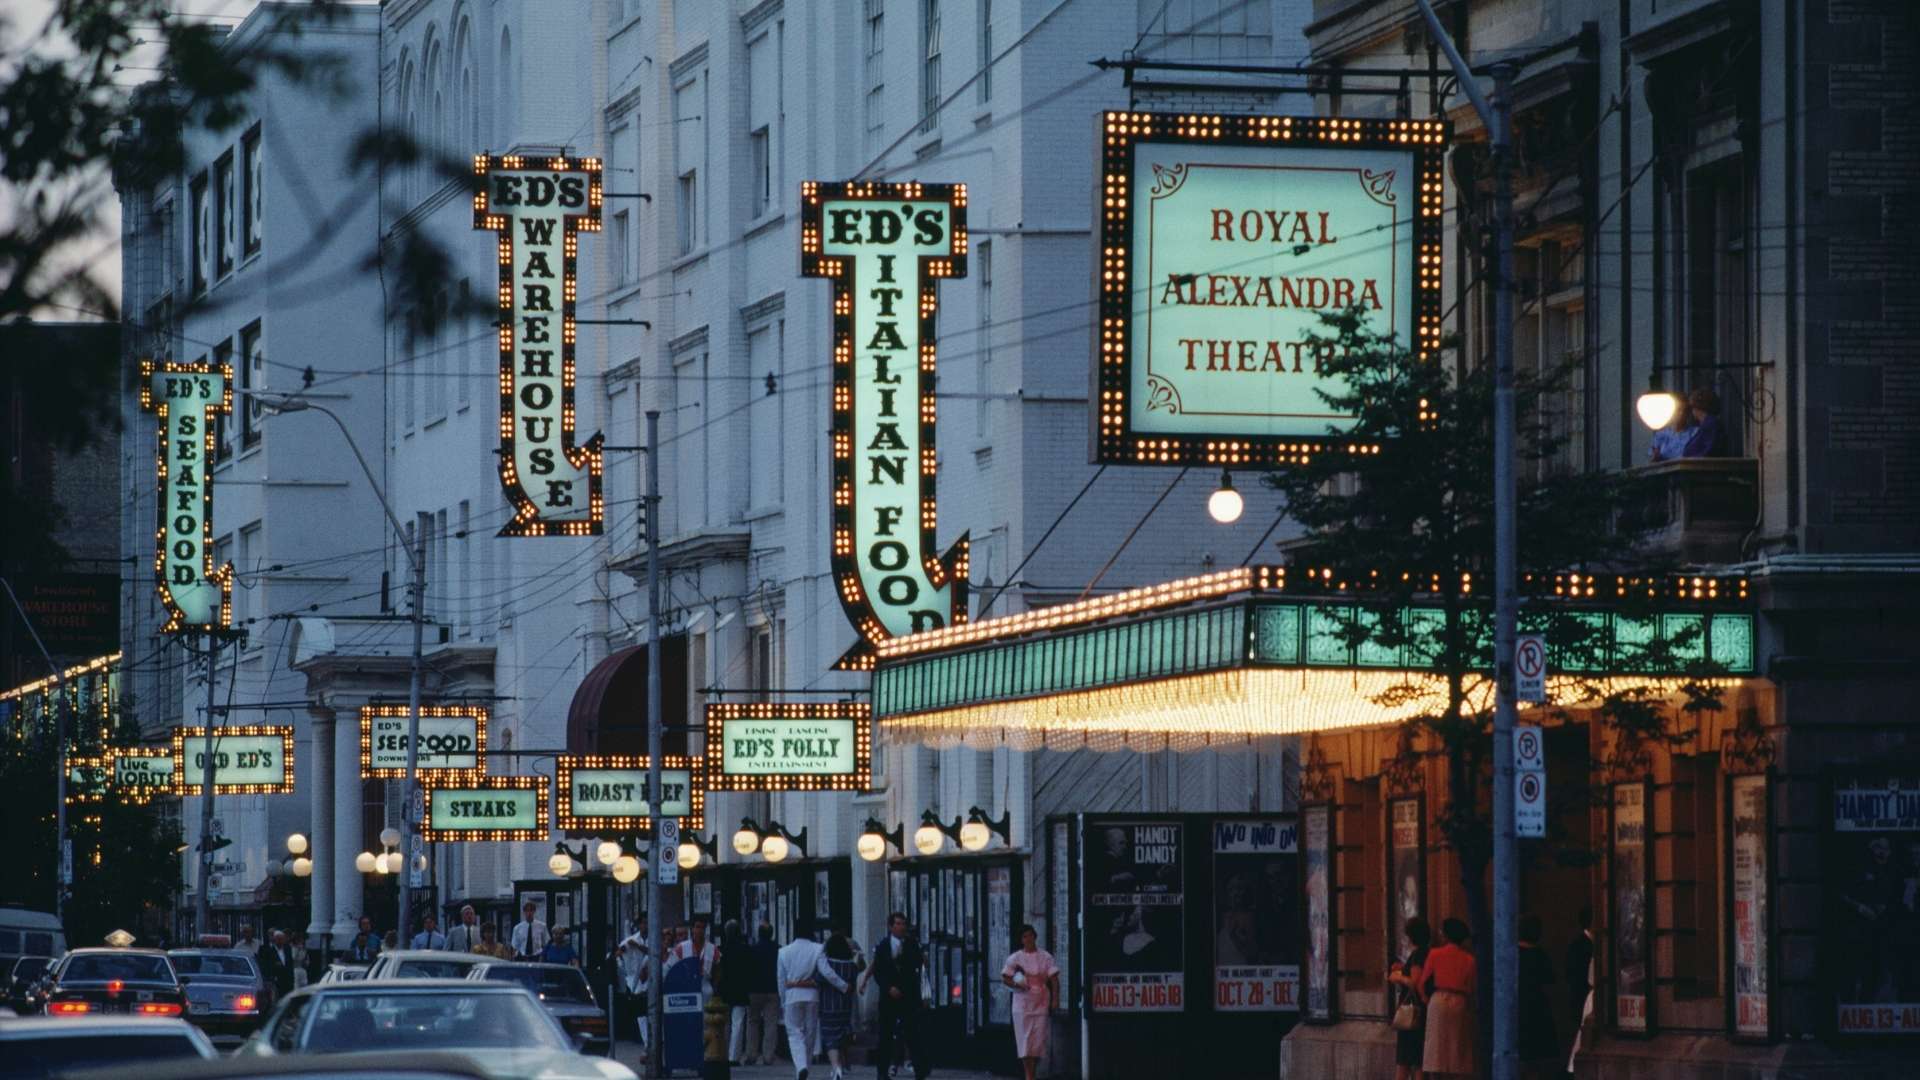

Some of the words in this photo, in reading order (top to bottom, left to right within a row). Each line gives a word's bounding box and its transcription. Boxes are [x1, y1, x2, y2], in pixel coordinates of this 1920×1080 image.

[492, 173, 585, 208] ED'S
[828, 204, 944, 246] ED'S
[1210, 208, 1337, 244] ROYAL
[1160, 273, 1383, 310] ALEXANDRA
[519, 218, 573, 507] WAREHOUSE
[1178, 339, 1358, 373] THEATR
[866, 254, 908, 485] ITALIAN
[165, 376, 211, 399] ED'S
[173, 415, 198, 586] SEAFOOD
[868, 505, 945, 634] FOOD
[378, 722, 402, 731] ED'S
[377, 735, 471, 751] SEAFOOD
[733, 738, 774, 758] ED'S
[782, 738, 841, 758] FOLLY
[121, 759, 149, 770] Live
[195, 752, 229, 769] OD
[236, 749, 273, 768] ED'S
[578, 783, 634, 801] ROAST
[450, 801, 516, 817] STEAKS
[1837, 794, 1891, 818] HANDY
[1134, 826, 1177, 844] HANDY
[1134, 845, 1177, 865] DANDY
